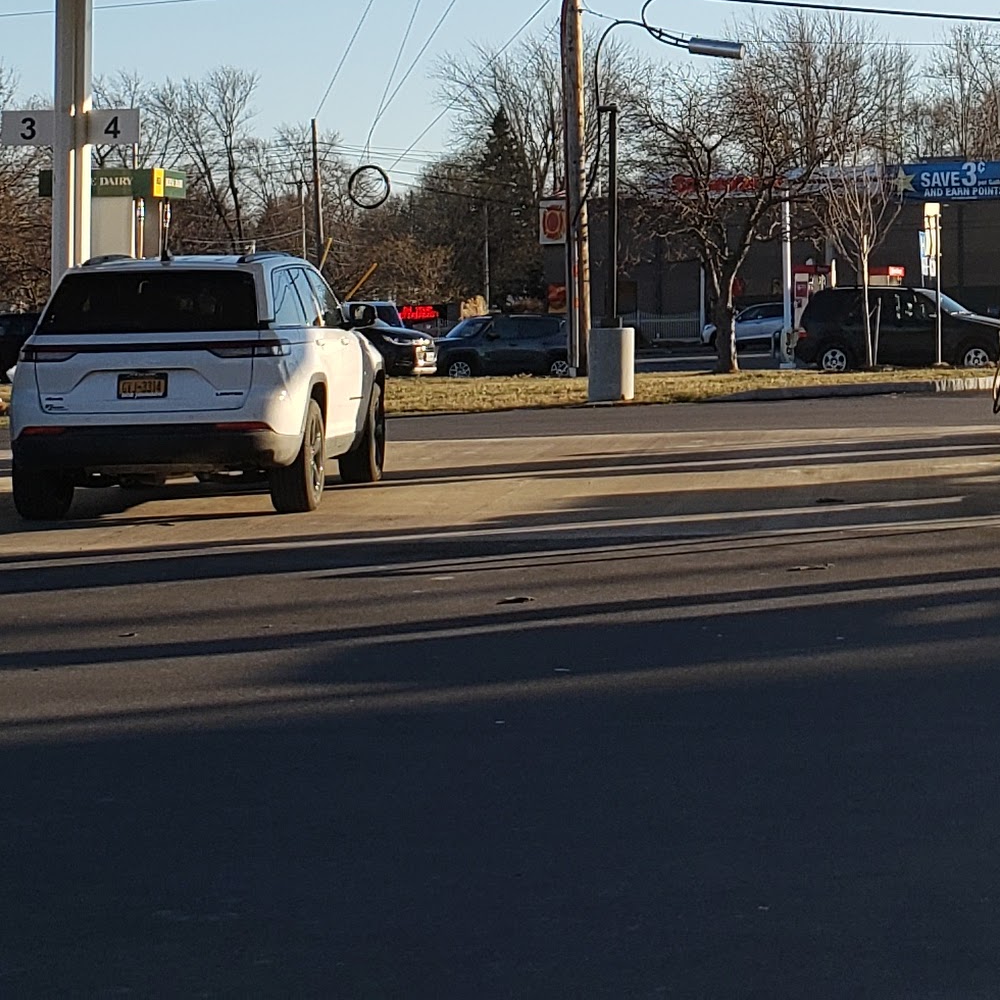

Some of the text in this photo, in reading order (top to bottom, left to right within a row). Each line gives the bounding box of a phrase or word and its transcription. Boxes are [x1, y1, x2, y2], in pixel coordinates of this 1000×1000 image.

[20, 117, 36, 140] 3
[104, 116, 121, 138] 4
[100, 176, 133, 186] DAIRY
[921, 172, 960, 187] SAVE
[924, 188, 943, 197] AND
[946, 187, 970, 197] EARN
